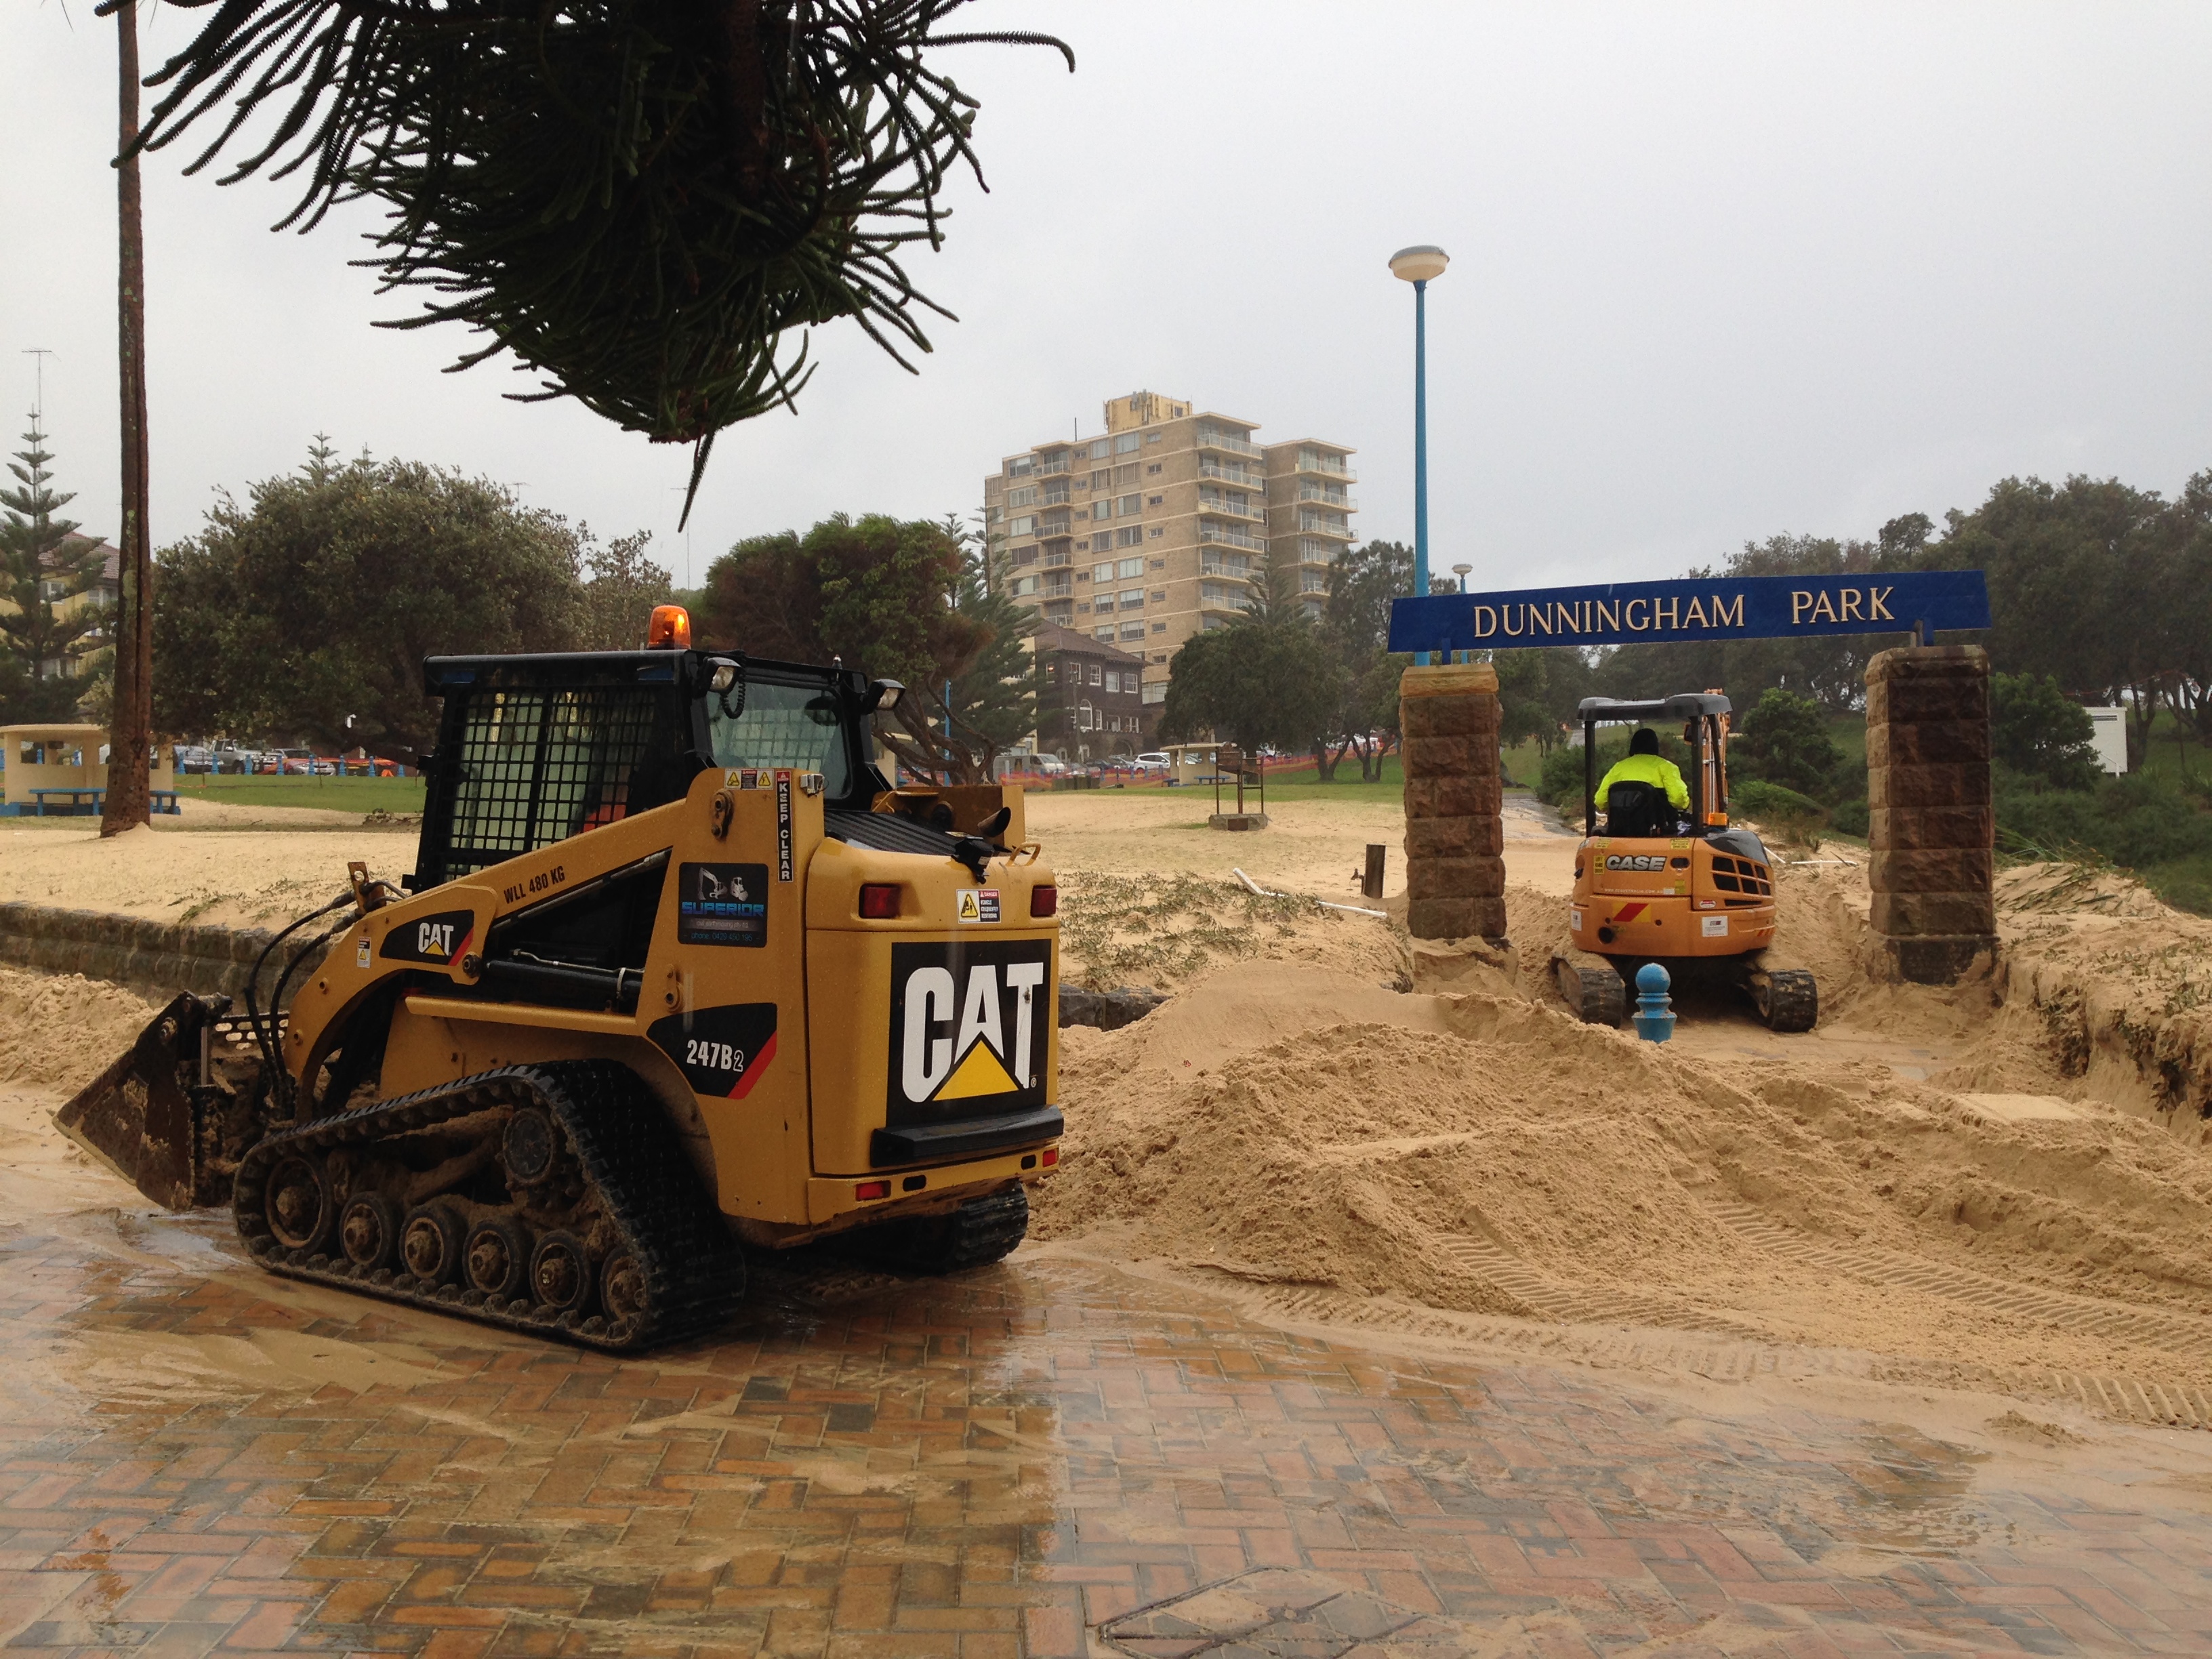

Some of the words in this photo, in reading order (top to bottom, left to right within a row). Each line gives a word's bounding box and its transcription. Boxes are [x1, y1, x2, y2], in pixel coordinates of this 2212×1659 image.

[1473, 594, 1745, 638] DUNNINGHAM
[1791, 586, 1896, 625] PARK
[779, 783, 788, 823] KEEP
[780, 830, 790, 880] CLEAR
[1606, 855, 1666, 871] CASE
[504, 883, 527, 904] WLL
[529, 873, 549, 893] 480
[550, 865, 565, 885] KG
[682, 901, 764, 916] SUPERIOR
[418, 922, 454, 956] CAT
[712, 933, 727, 941] 0429
[902, 962, 1044, 1103] CAT
[687, 1039, 744, 1073] 247B2
